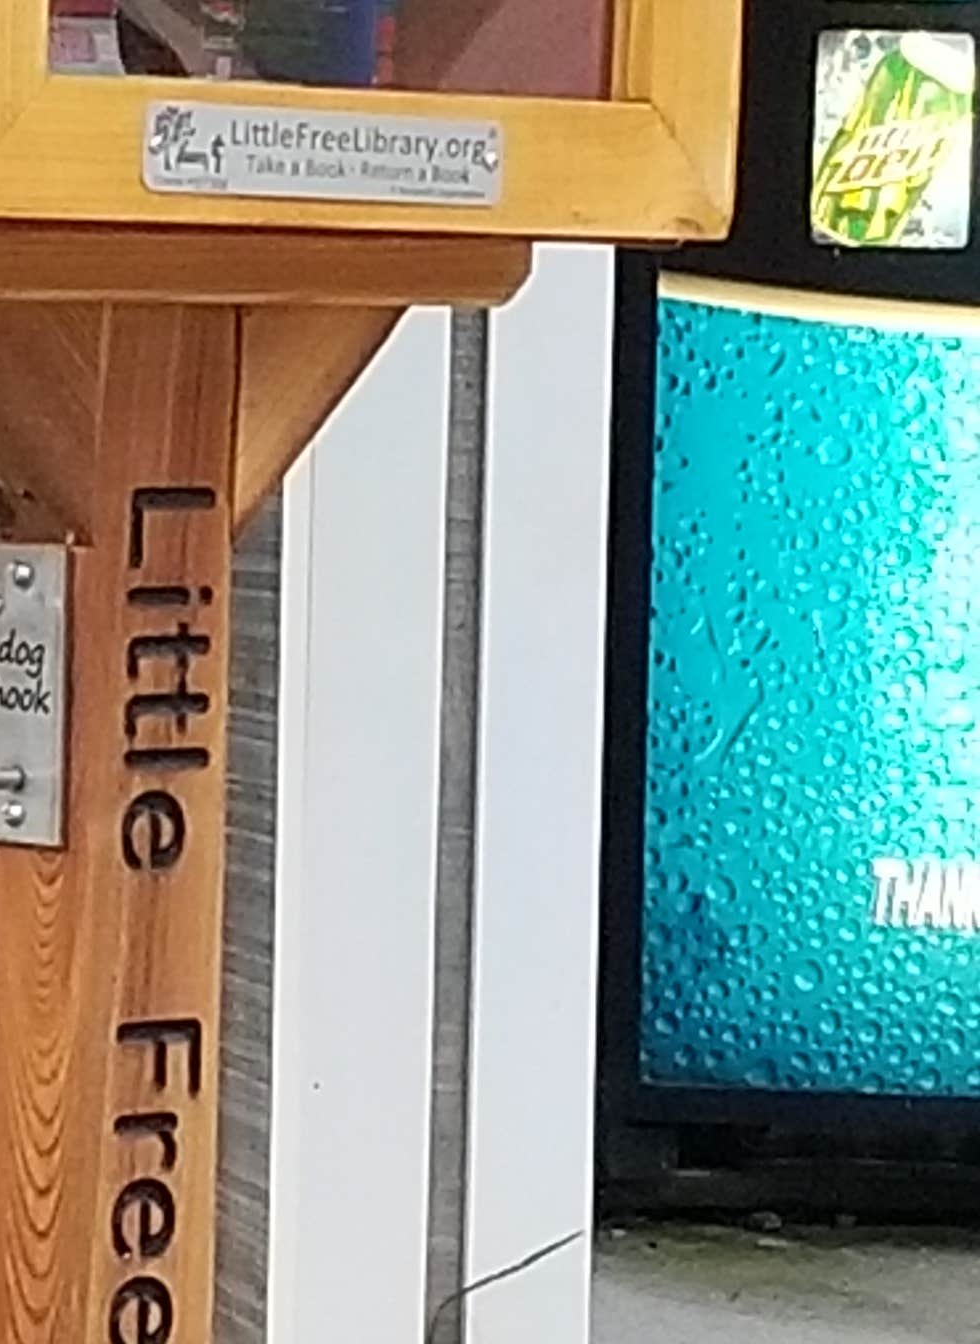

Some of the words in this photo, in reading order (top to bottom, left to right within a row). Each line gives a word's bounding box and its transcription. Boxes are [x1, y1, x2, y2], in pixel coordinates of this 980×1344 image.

[229, 119, 489, 167] LittleFreeLibrary.org
[245, 154, 285, 177] Take
[306, 158, 346, 180] Book
[361, 160, 414, 182] Return
[431, 164, 471, 186] Book
[121, 486, 217, 870] Little
